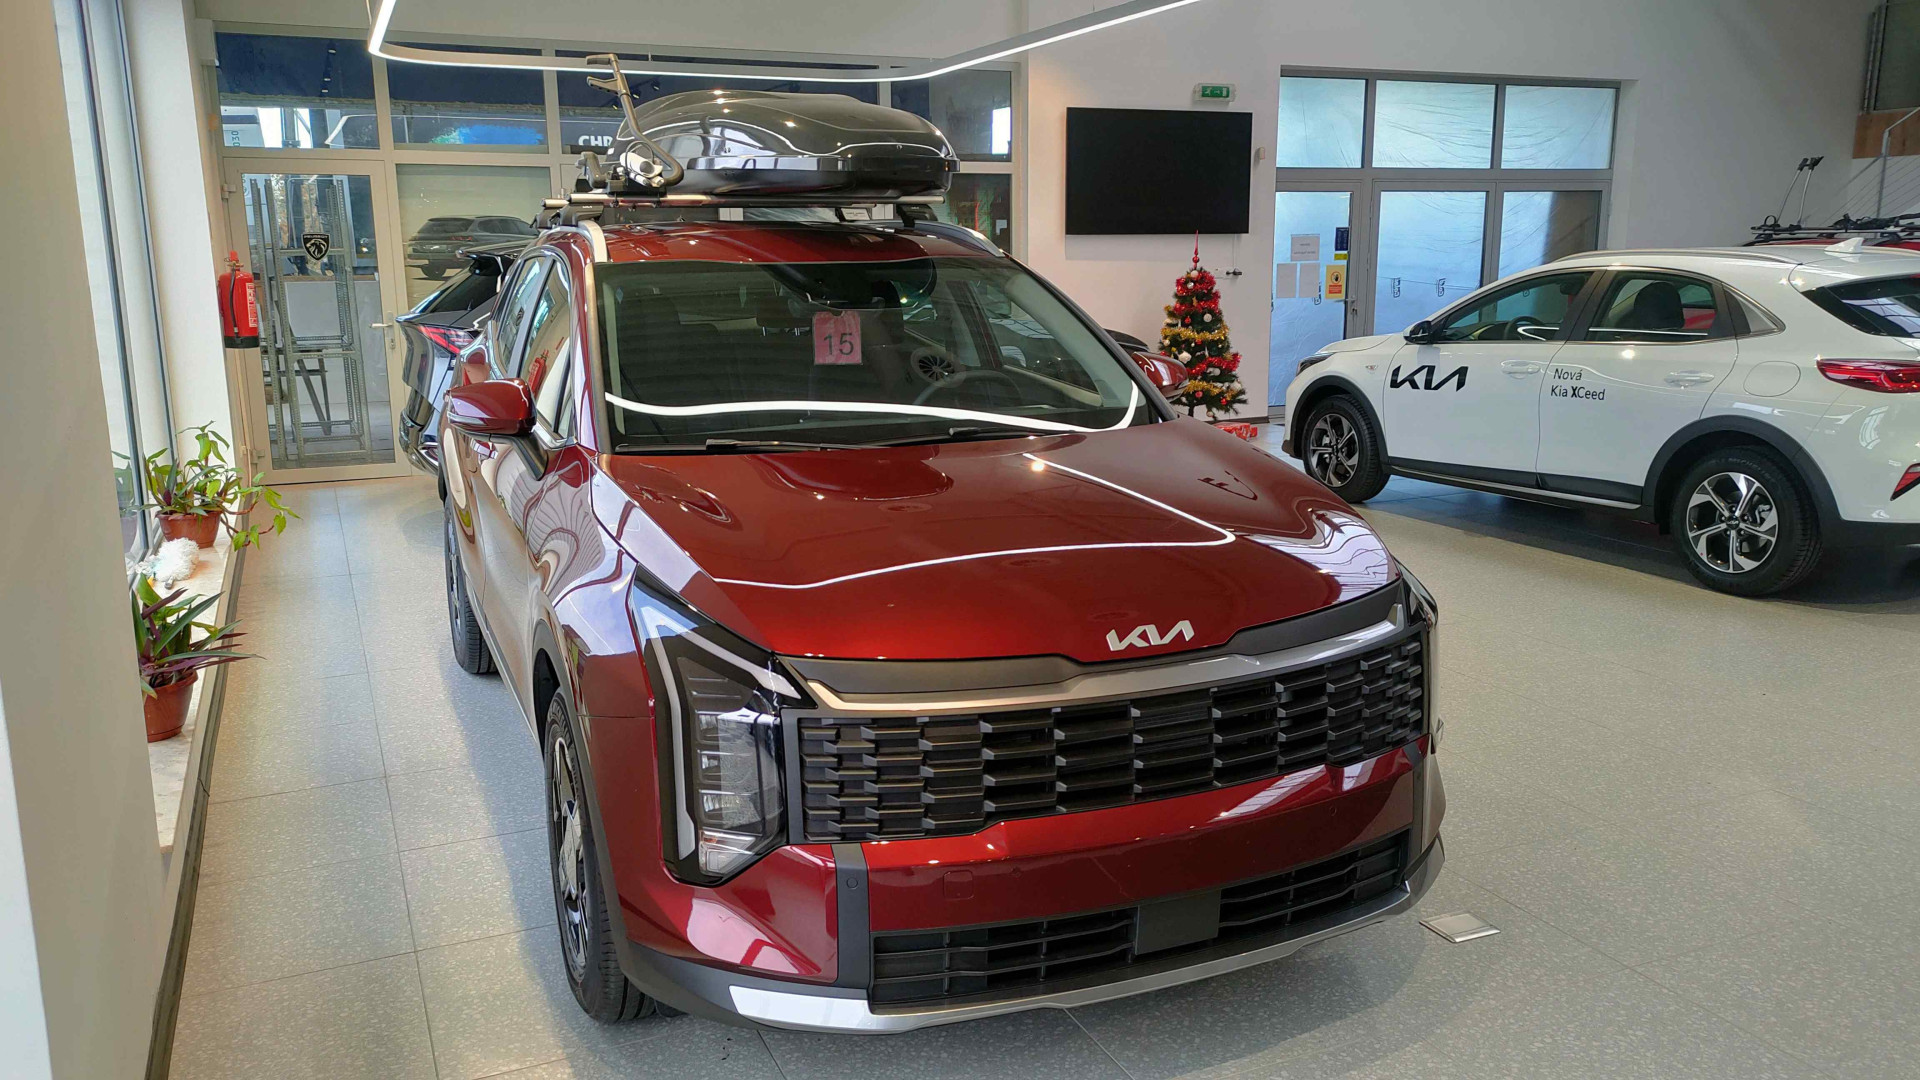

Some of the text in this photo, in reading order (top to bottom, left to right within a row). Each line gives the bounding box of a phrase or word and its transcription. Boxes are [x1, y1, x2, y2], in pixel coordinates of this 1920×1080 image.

[823, 332, 854, 356] 15
[1390, 364, 1469, 391] KIA
[1553, 368, 1583, 381] Nová
[1550, 384, 1606, 401] Kia XCeed
[1106, 619, 1195, 652] KIA
